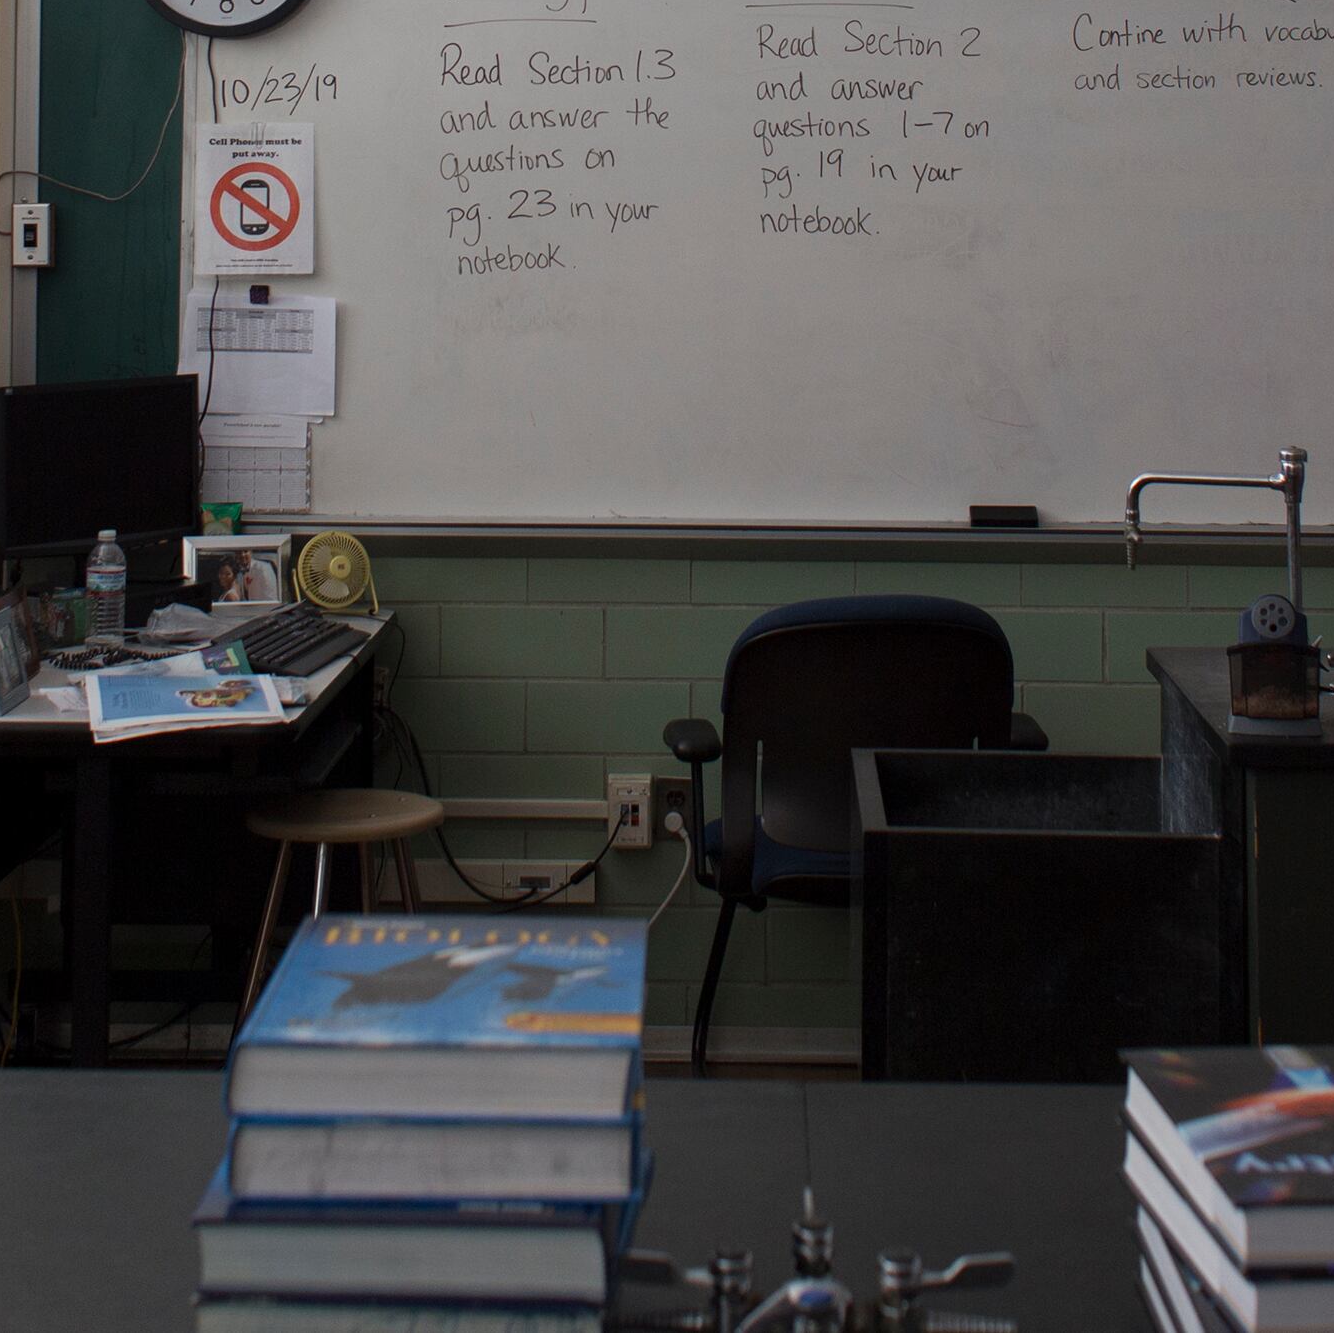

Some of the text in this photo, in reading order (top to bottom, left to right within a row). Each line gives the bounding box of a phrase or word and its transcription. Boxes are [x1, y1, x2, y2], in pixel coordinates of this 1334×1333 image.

[756, 19, 982, 59] Read Section 2
[1072, 12, 1167, 51] Contine
[1182, 12, 1248, 44] with
[440, 42, 676, 85] Read Section 1.3
[1074, 64, 1324, 91] and section reviews.
[221, 63, 338, 116] 10/23/19
[756, 71, 924, 101] and answer
[440, 96, 670, 134] and answer the
[753, 110, 990, 157] questions 1-7 on
[209, 138, 228, 146] Cell
[265, 138, 289, 146] must
[290, 137, 303, 146] be
[232, 150, 279, 159] put away.
[439, 144, 616, 193] questions on
[761, 148, 963, 199] pg. 19 in your
[446, 189, 659, 247] pg. 23 in your
[760, 203, 881, 236] notebook.
[458, 243, 577, 275] notebook.
